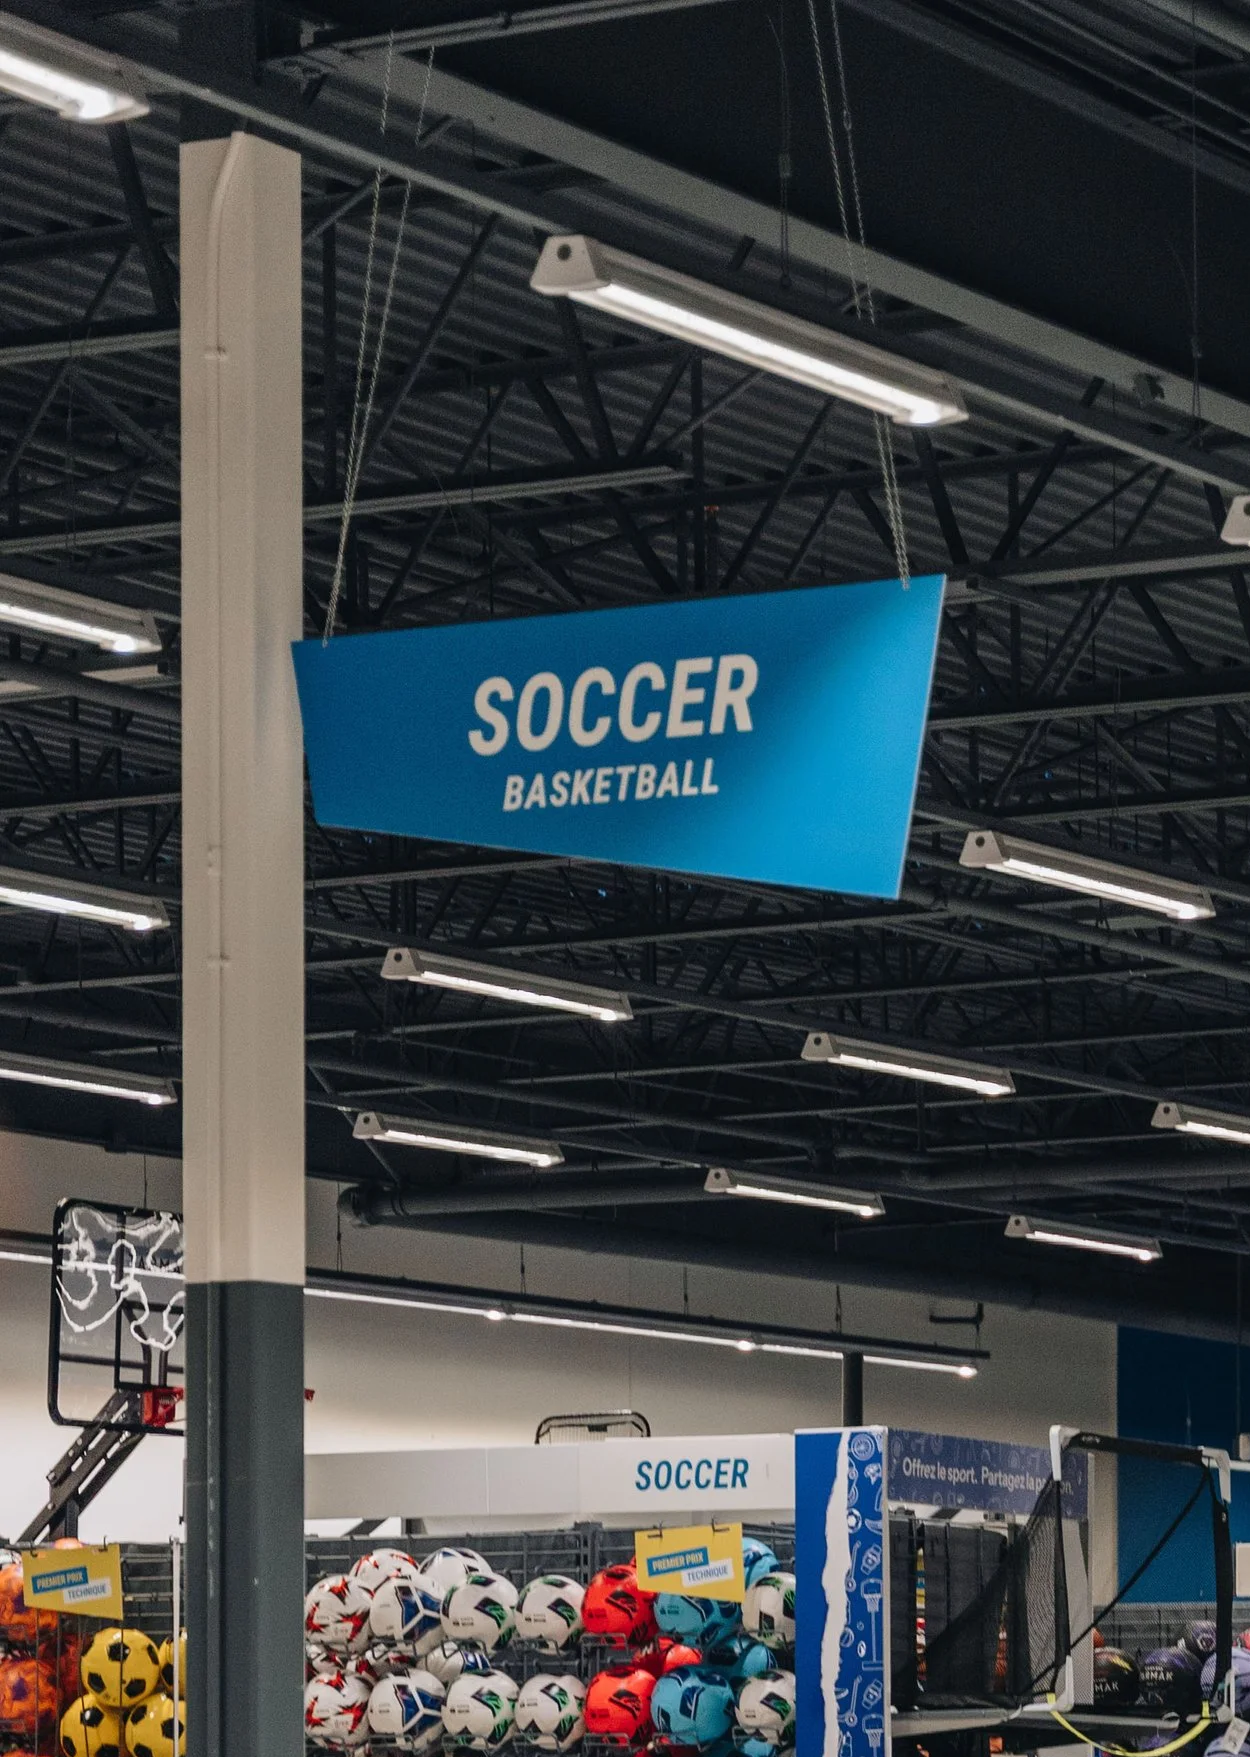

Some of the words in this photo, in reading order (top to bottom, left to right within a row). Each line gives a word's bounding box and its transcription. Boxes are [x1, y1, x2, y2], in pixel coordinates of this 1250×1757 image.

[468, 654, 758, 756] SOCCER
[503, 757, 719, 812] BASKETBALL
[635, 1458, 749, 1491] SOCCER
[903, 1456, 936, 1478] Offrez
[937, 1465, 946, 1480] le
[948, 1467, 977, 1485] sport.
[982, 1466, 1025, 1492] Partagez
[1026, 1473, 1035, 1490] la
[652, 1554, 685, 1571] PREMIER
[686, 1551, 704, 1566] PRIX
[687, 1564, 728, 1582] TECHNIQUE
[68, 1583, 106, 1599] TECHNIQUE
